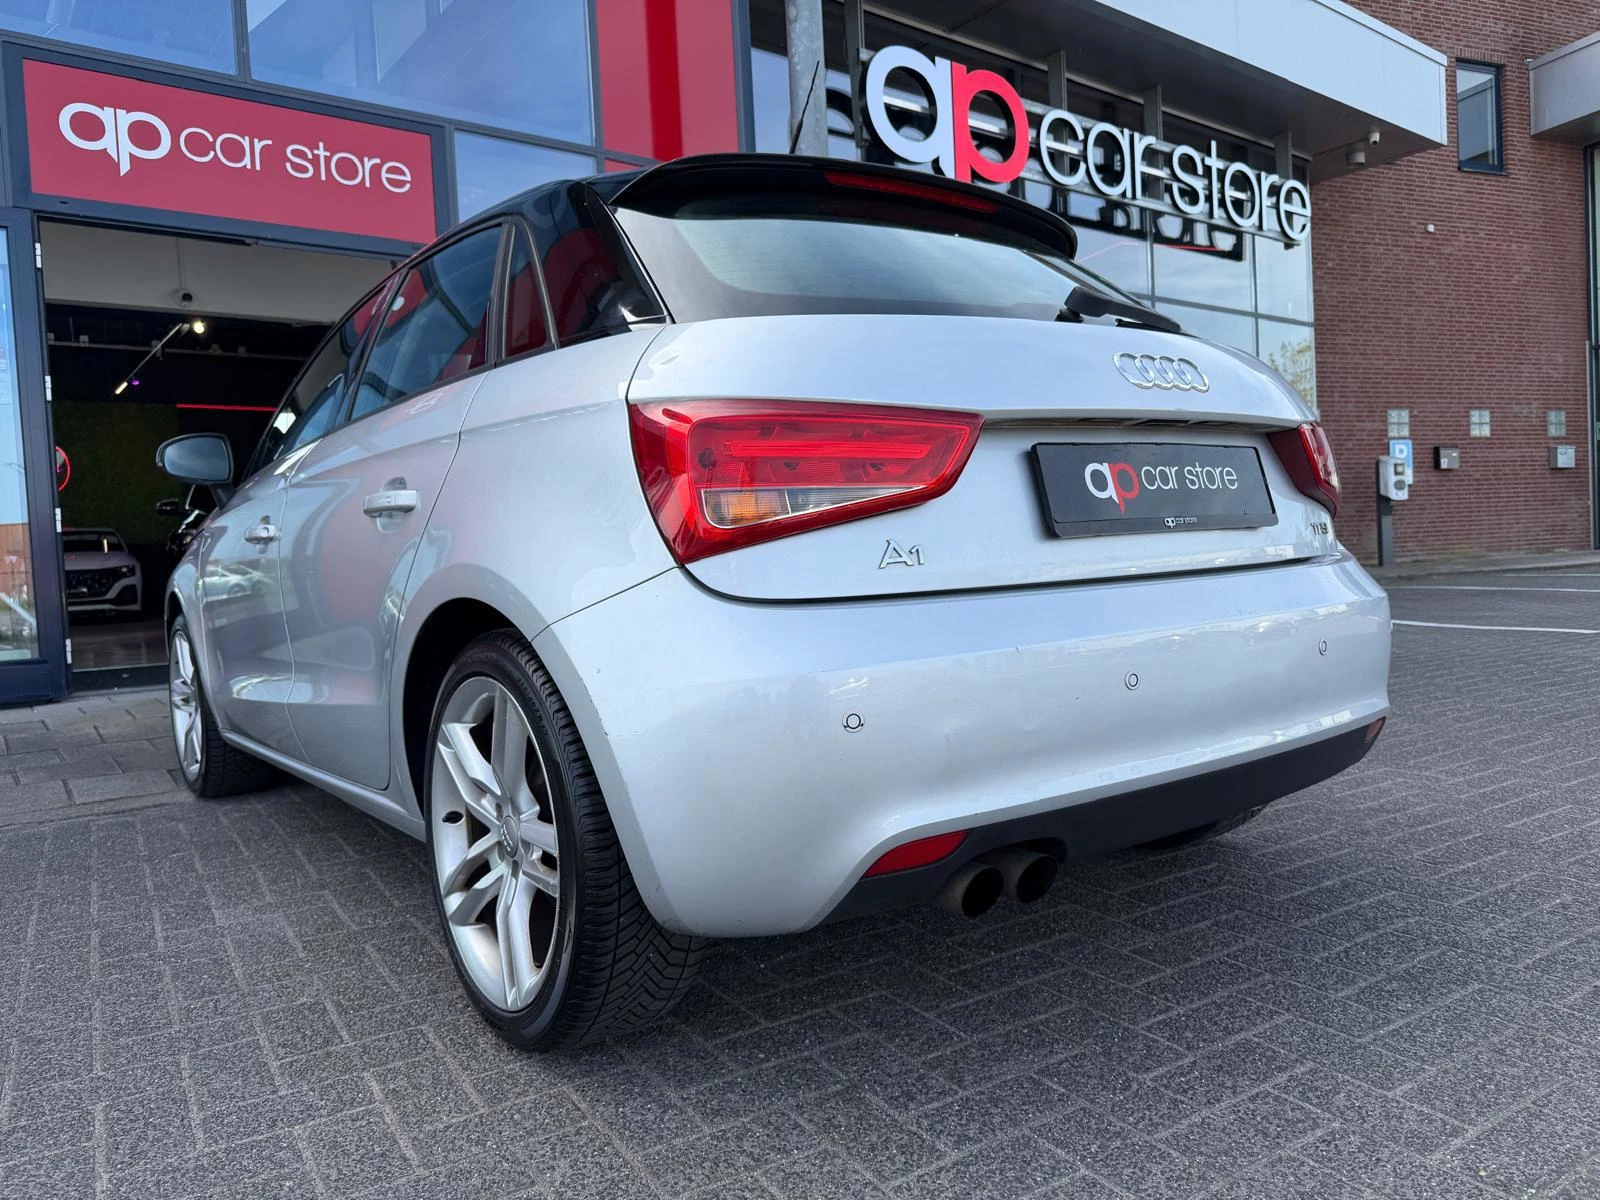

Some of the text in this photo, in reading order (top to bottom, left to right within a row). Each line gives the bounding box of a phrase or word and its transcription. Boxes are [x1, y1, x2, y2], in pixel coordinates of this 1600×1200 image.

[58, 102, 412, 193] ap car store
[866, 45, 1030, 183] ap
[1039, 109, 1156, 200] car
[1172, 139, 1311, 241] store
[1084, 462, 1238, 514] ap car store
[1164, 517, 1176, 528] ap
[1184, 516, 1198, 524] store
[878, 538, 925, 569] A1
